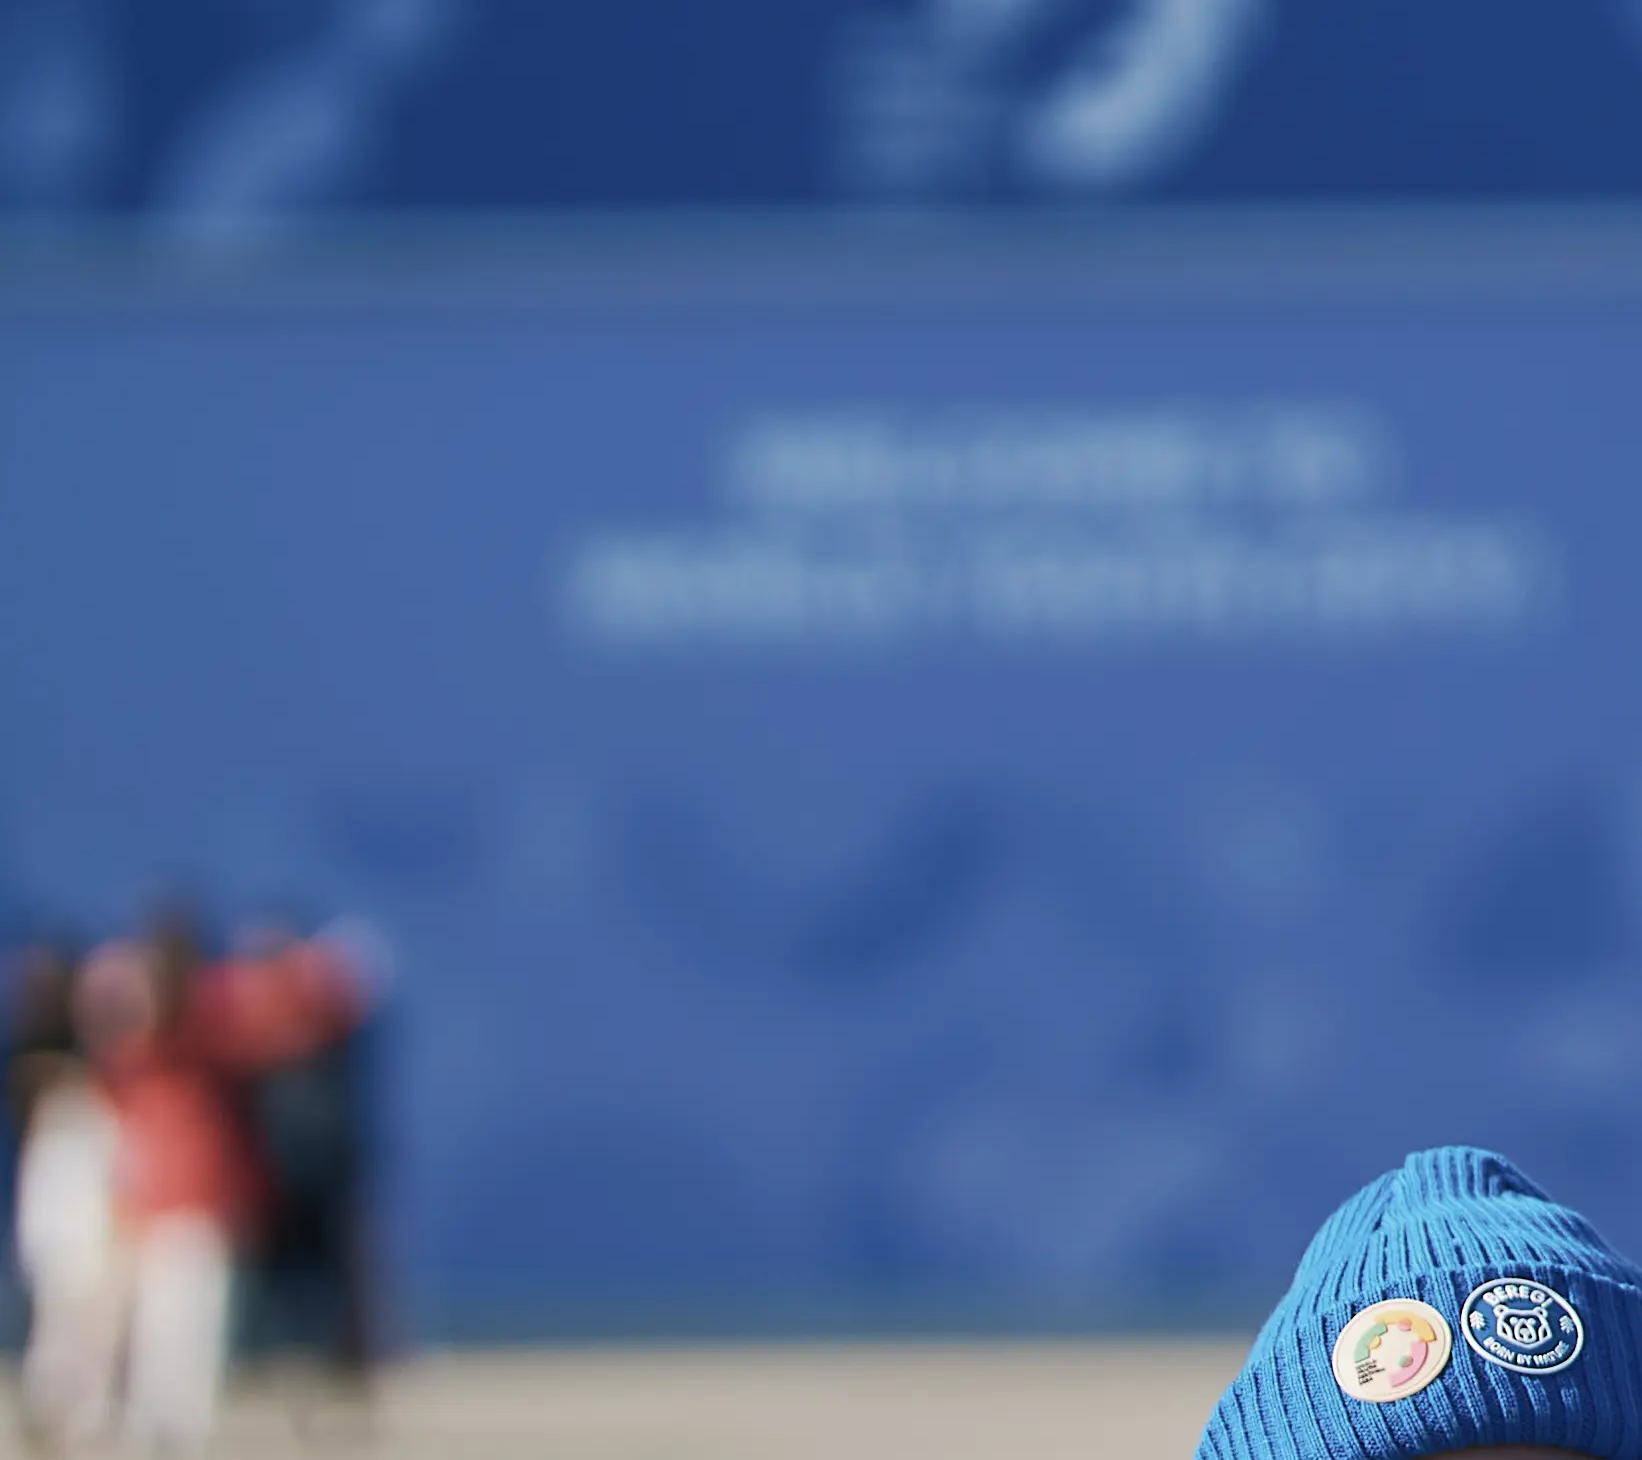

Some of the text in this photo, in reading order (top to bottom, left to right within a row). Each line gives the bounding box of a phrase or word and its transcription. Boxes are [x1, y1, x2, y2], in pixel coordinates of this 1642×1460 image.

[1483, 1284, 1554, 1308] BEREGI
[1483, 1336, 1570, 1366] BORN BY NATURE
